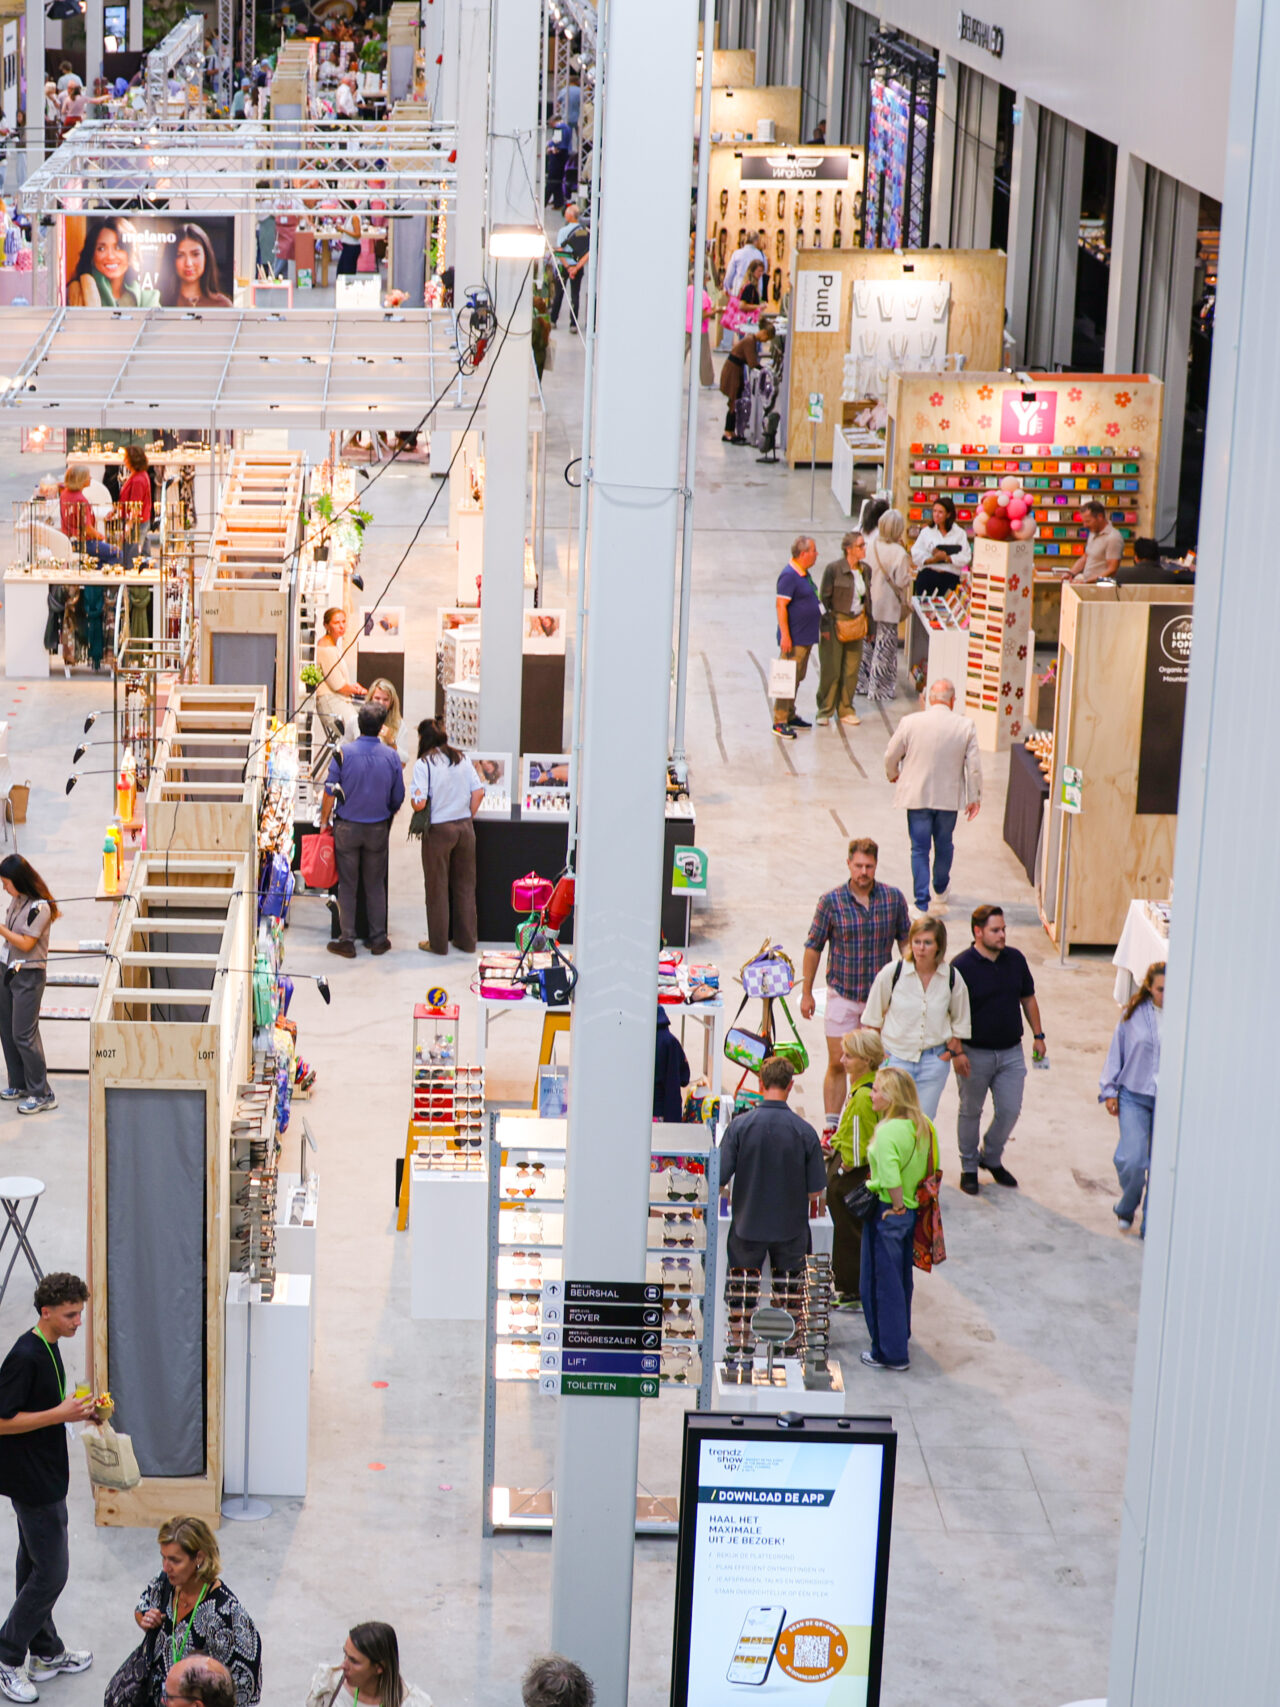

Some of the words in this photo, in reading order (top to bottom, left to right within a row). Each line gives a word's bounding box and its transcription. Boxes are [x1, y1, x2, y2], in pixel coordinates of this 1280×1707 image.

[122, 229, 177, 244] melano
[816, 275, 833, 327] PuuR
[1172, 631, 1194, 640] LENO
[1158, 666, 1183, 674] Organic
[95, 1049, 116, 1059] M02T
[198, 1050, 215, 1060] L01T
[570, 1288, 619, 1298] BEURSHAL
[569, 1313, 600, 1322] FOYER
[568, 1335, 637, 1345] CONGRESZALEN
[567, 1358, 587, 1366] LIFT
[567, 1381, 617, 1390] TOILETTEN
[708, 1447, 742, 1456] trendz
[717, 1455, 744, 1463] show
[718, 1490, 782, 1503] DOWNLOAD
[784, 1492, 800, 1503] DE
[801, 1493, 825, 1504] APP
[709, 1515, 736, 1524] HAAL
[739, 1516, 760, 1524] HET
[708, 1525, 762, 1535] MAXIMALE
[708, 1535, 725, 1544] UIT
[727, 1536, 739, 1545] JE
[742, 1536, 785, 1546] BEZOEK!
